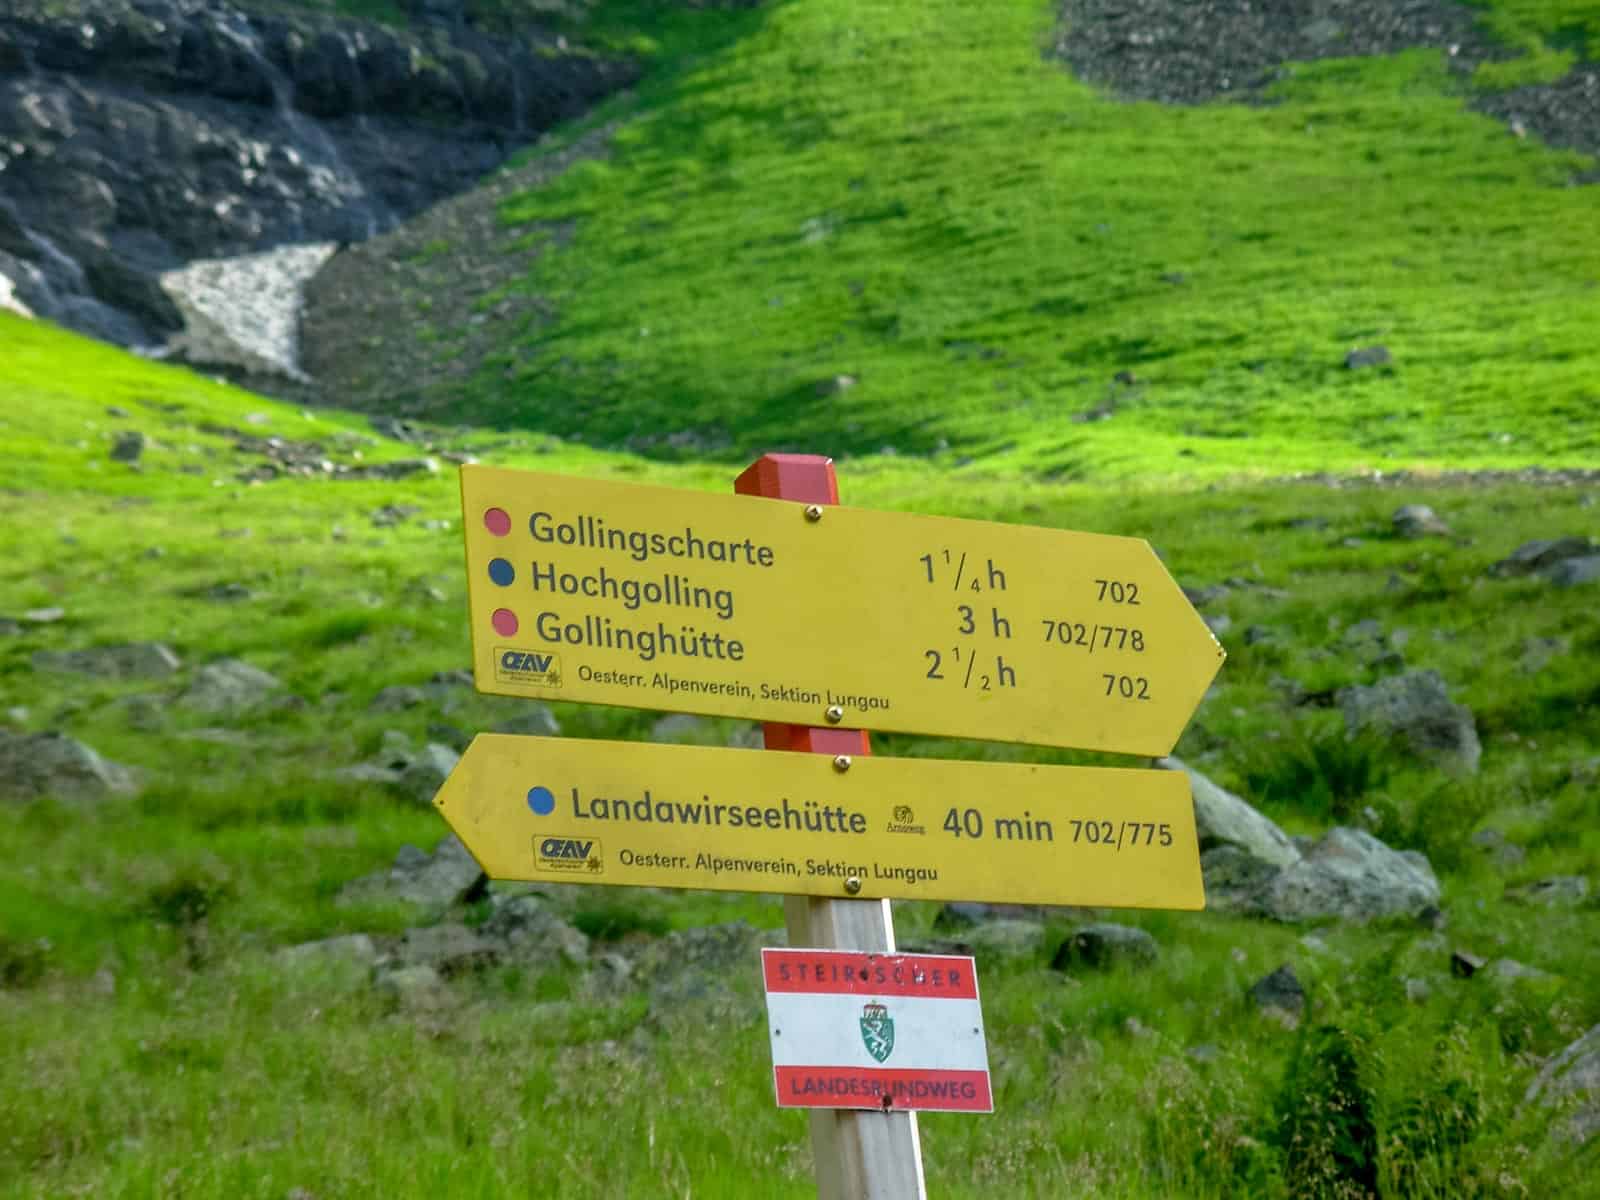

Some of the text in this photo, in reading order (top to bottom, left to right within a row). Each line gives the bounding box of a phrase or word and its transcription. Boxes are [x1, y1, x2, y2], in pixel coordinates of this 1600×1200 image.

[528, 511, 775, 567] Gollingscharte
[987, 559, 1006, 590] h
[1094, 580, 1141, 605] 702
[531, 561, 1145, 653] Hochgolling 3 h 702/778
[536, 611, 745, 661] Gollinghütte
[997, 655, 1016, 688] h
[1102, 674, 1151, 700] 702
[578, 666, 890, 712] Oesterr. Alpenverein, Sektion Lungau
[571, 788, 867, 834] Landawirseehütte
[942, 808, 983, 839] 40
[994, 811, 1053, 842] min
[1069, 820, 1173, 851] 702/775
[620, 850, 938, 884] Oesterr. Alpenverein, Sektion Lungau
[779, 963, 961, 988] STEIRSCHER
[791, 1077, 976, 1100] LANDESRUNDWEG
